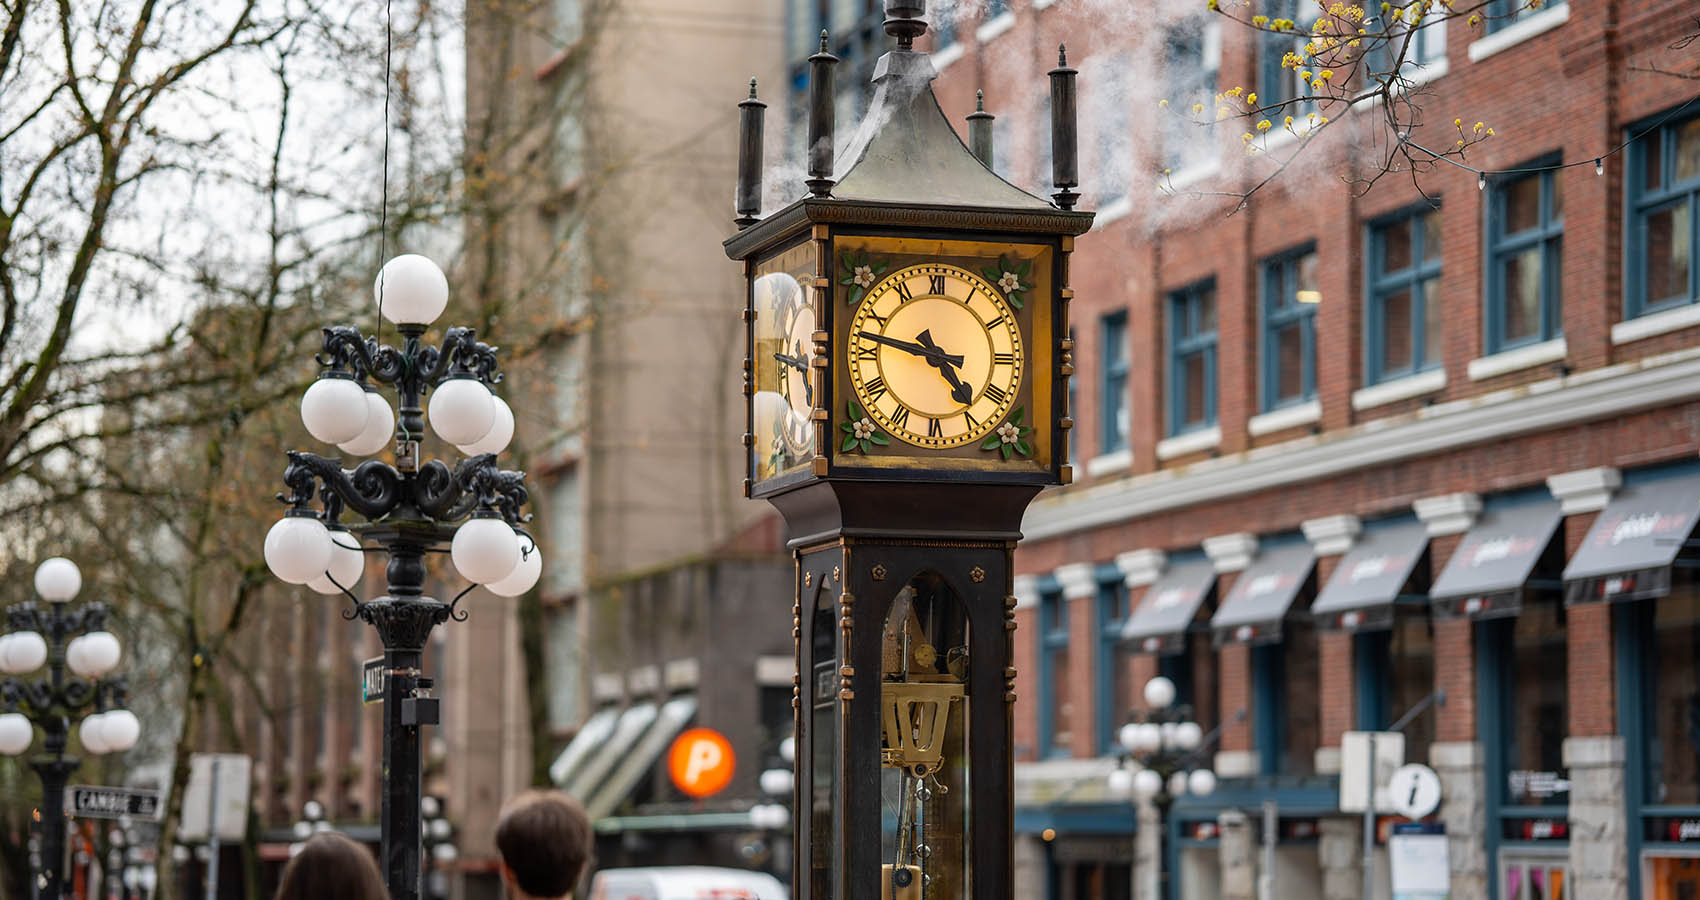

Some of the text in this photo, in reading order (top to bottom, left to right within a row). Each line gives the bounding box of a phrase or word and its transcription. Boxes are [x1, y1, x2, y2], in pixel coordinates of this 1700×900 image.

[893, 281, 912, 304] XI
[929, 275, 945, 295] XII
[965, 287, 976, 304] I
[867, 309, 888, 328] X
[986, 316, 1003, 331] II
[858, 347, 877, 360] IX
[994, 353, 1013, 365] III
[864, 376, 888, 403] VIII
[983, 383, 1006, 405] IIII
[890, 404, 909, 429] VII
[964, 411, 979, 430] V
[929, 418, 943, 438] VI
[685, 740, 722, 784] P
[1408, 773, 1420, 806] i
